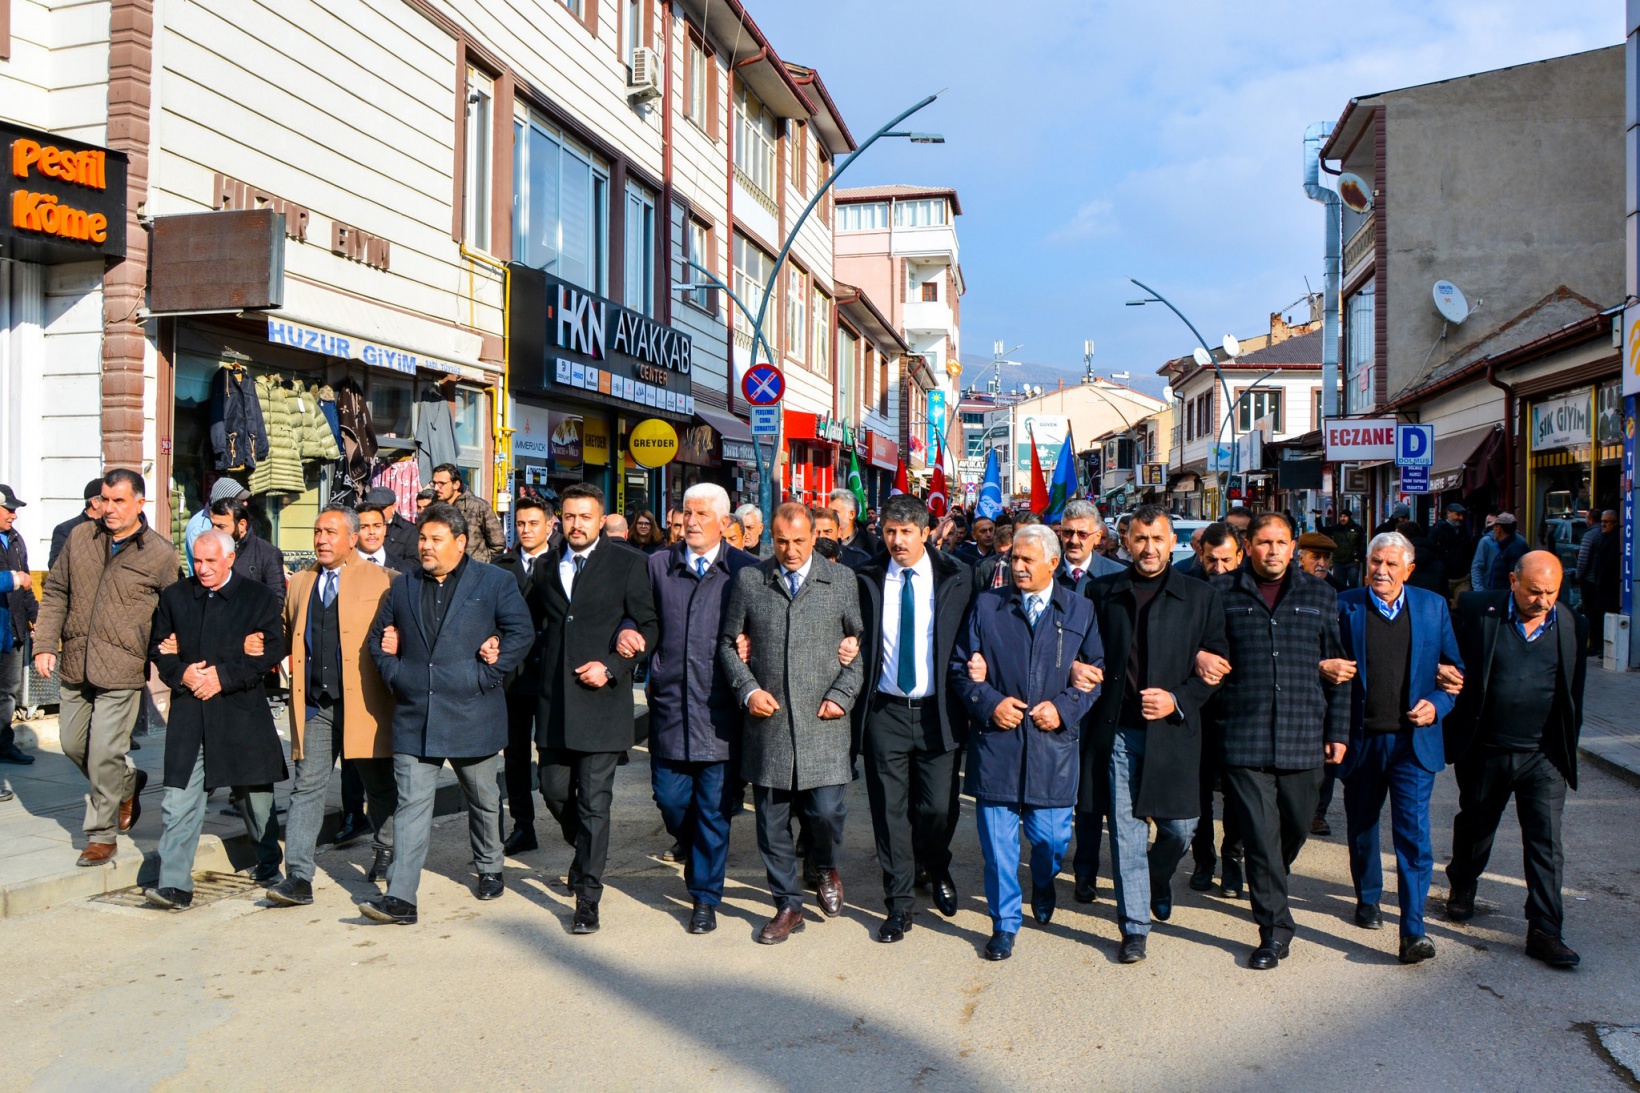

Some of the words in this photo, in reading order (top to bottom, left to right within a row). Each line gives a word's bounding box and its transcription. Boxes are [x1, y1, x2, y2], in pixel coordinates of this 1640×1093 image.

[12, 138, 106, 190] Pestil
[12, 189, 107, 243] Köme
[557, 284, 606, 360] HKN
[268, 321, 350, 360] HUZUR
[363, 345, 417, 375] GİYİM
[640, 363, 668, 386] CENTER
[755, 408, 775, 416] PERŞEMBE
[1556, 401, 1585, 432] GİYİM
[584, 433, 607, 449] GREYDER
[633, 438, 675, 448] GREYDER
[1329, 428, 1394, 446] ECZANE
[1402, 427, 1428, 458] D
[958, 460, 985, 468] AVUKAT
[1398, 457, 1430, 466] DOLMUŞ
